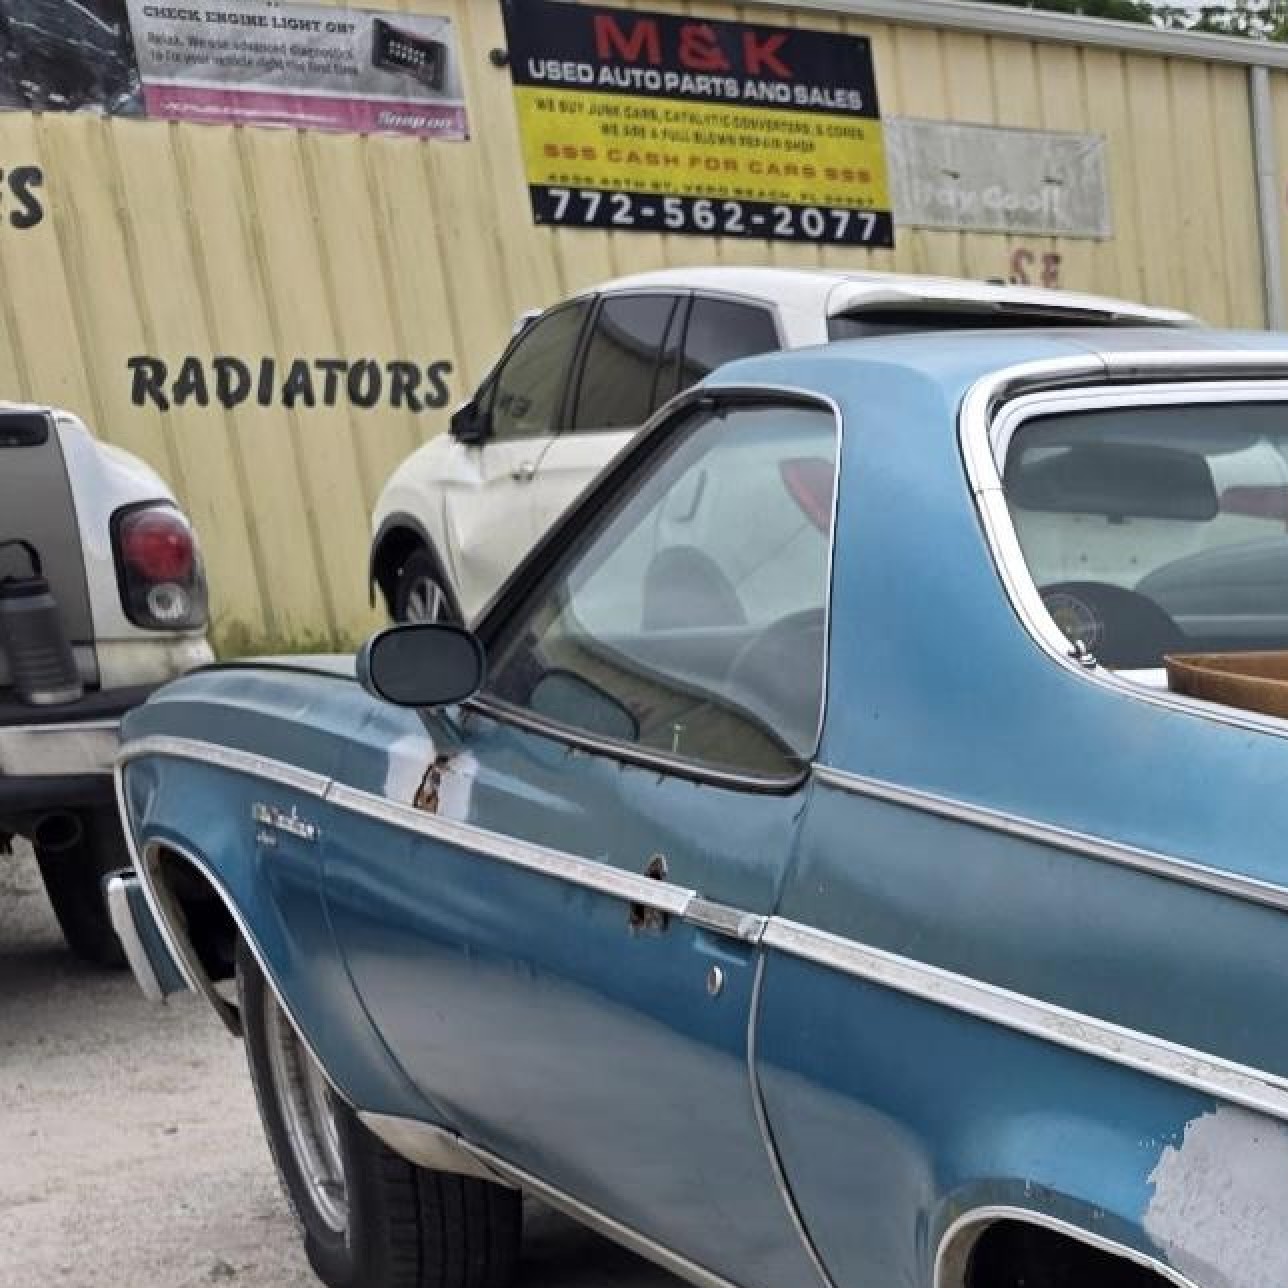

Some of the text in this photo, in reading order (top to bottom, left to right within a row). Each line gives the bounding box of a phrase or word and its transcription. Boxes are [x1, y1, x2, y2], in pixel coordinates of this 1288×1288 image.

[143, 5, 202, 22] CHECK
[205, 11, 269, 27] ENGINE
[271, 16, 321, 32] LIGHT
[594, 15, 794, 78] M & K
[528, 57, 863, 111] USED AUTO PARTS AND SALES
[606, 148, 680, 167] CASH
[688, 154, 738, 172] FOR
[748, 159, 816, 179] CARS
[0, 165, 44, 230] S
[547, 188, 878, 242] 772-562-2077
[127, 355, 454, 413] RADIATORS
